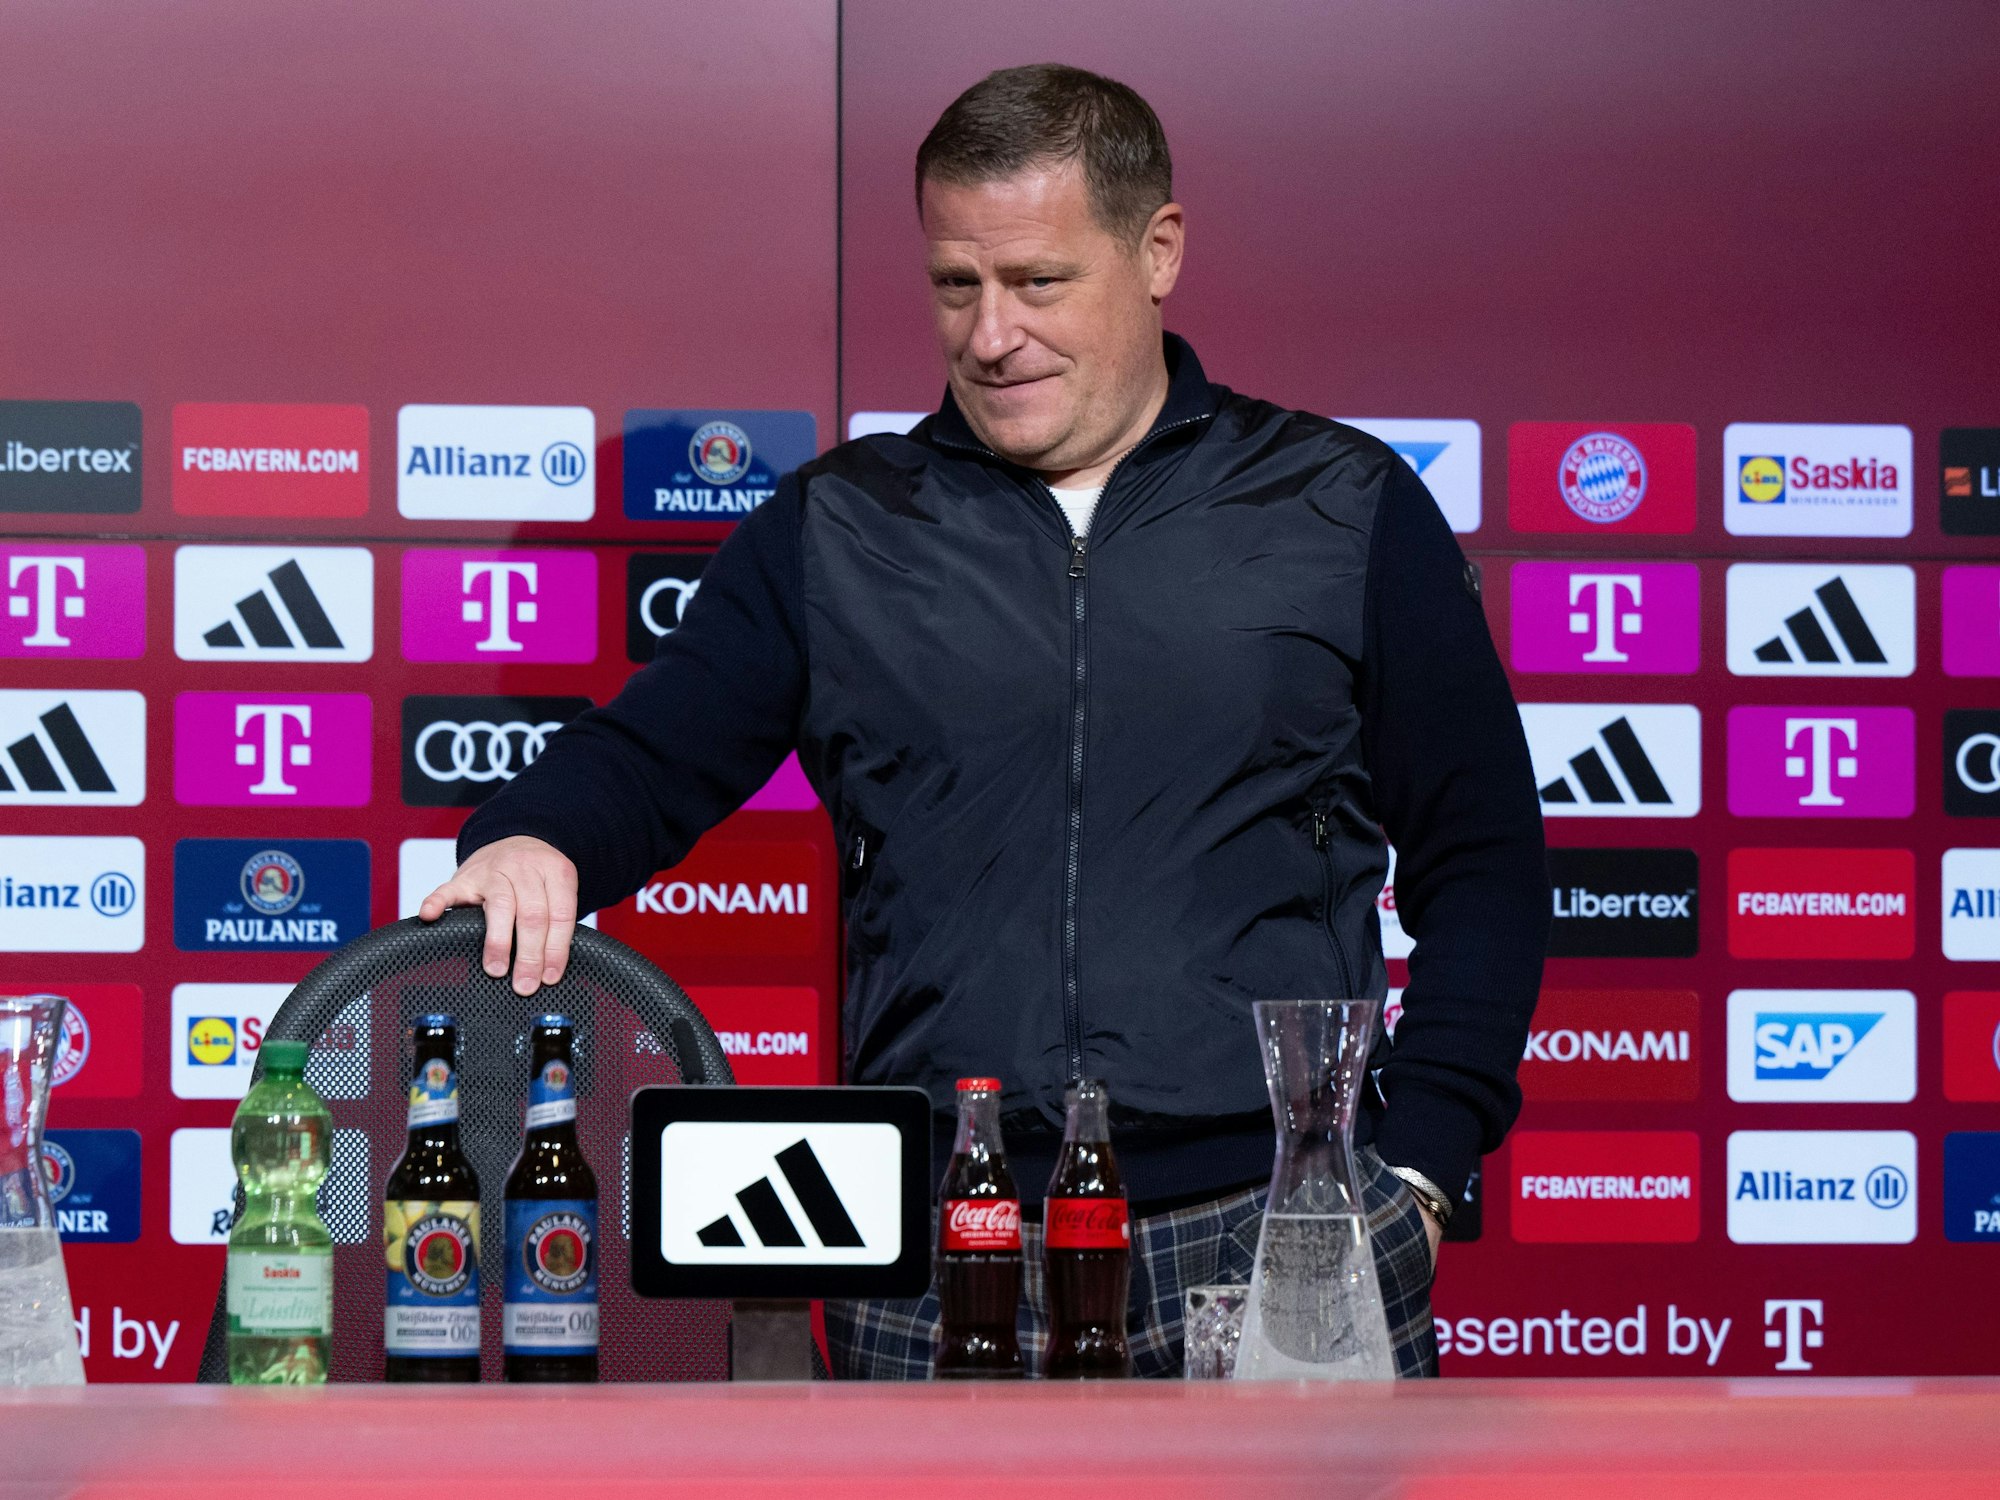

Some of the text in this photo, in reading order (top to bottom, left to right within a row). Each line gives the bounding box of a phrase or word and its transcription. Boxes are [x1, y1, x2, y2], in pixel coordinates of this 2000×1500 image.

[183, 447, 359, 473] FCBAYERN.COM
[406, 446, 531, 476] Allianz
[1790, 456, 1899, 491] Saskia
[654, 488, 776, 512] PAULANE
[0, 878, 80, 907] ianz
[636, 882, 808, 914] KONAMI
[1552, 888, 1691, 918] Libertex
[1738, 893, 1906, 916] FCBAYERN.COM
[1950, 889, 2000, 918] All
[205, 919, 338, 943] PAULANER
[1523, 1029, 1690, 1062] KONAMI
[1756, 1022, 1855, 1069] SAP
[1521, 1176, 1690, 1199] FCBAYERN.COM
[1735, 1171, 1855, 1201] Allianz
[407, 1217, 471, 1248] PAULANER
[528, 1214, 592, 1246] PAULANER
[113, 1306, 180, 1369] by
[1667, 1304, 1732, 1366] by
